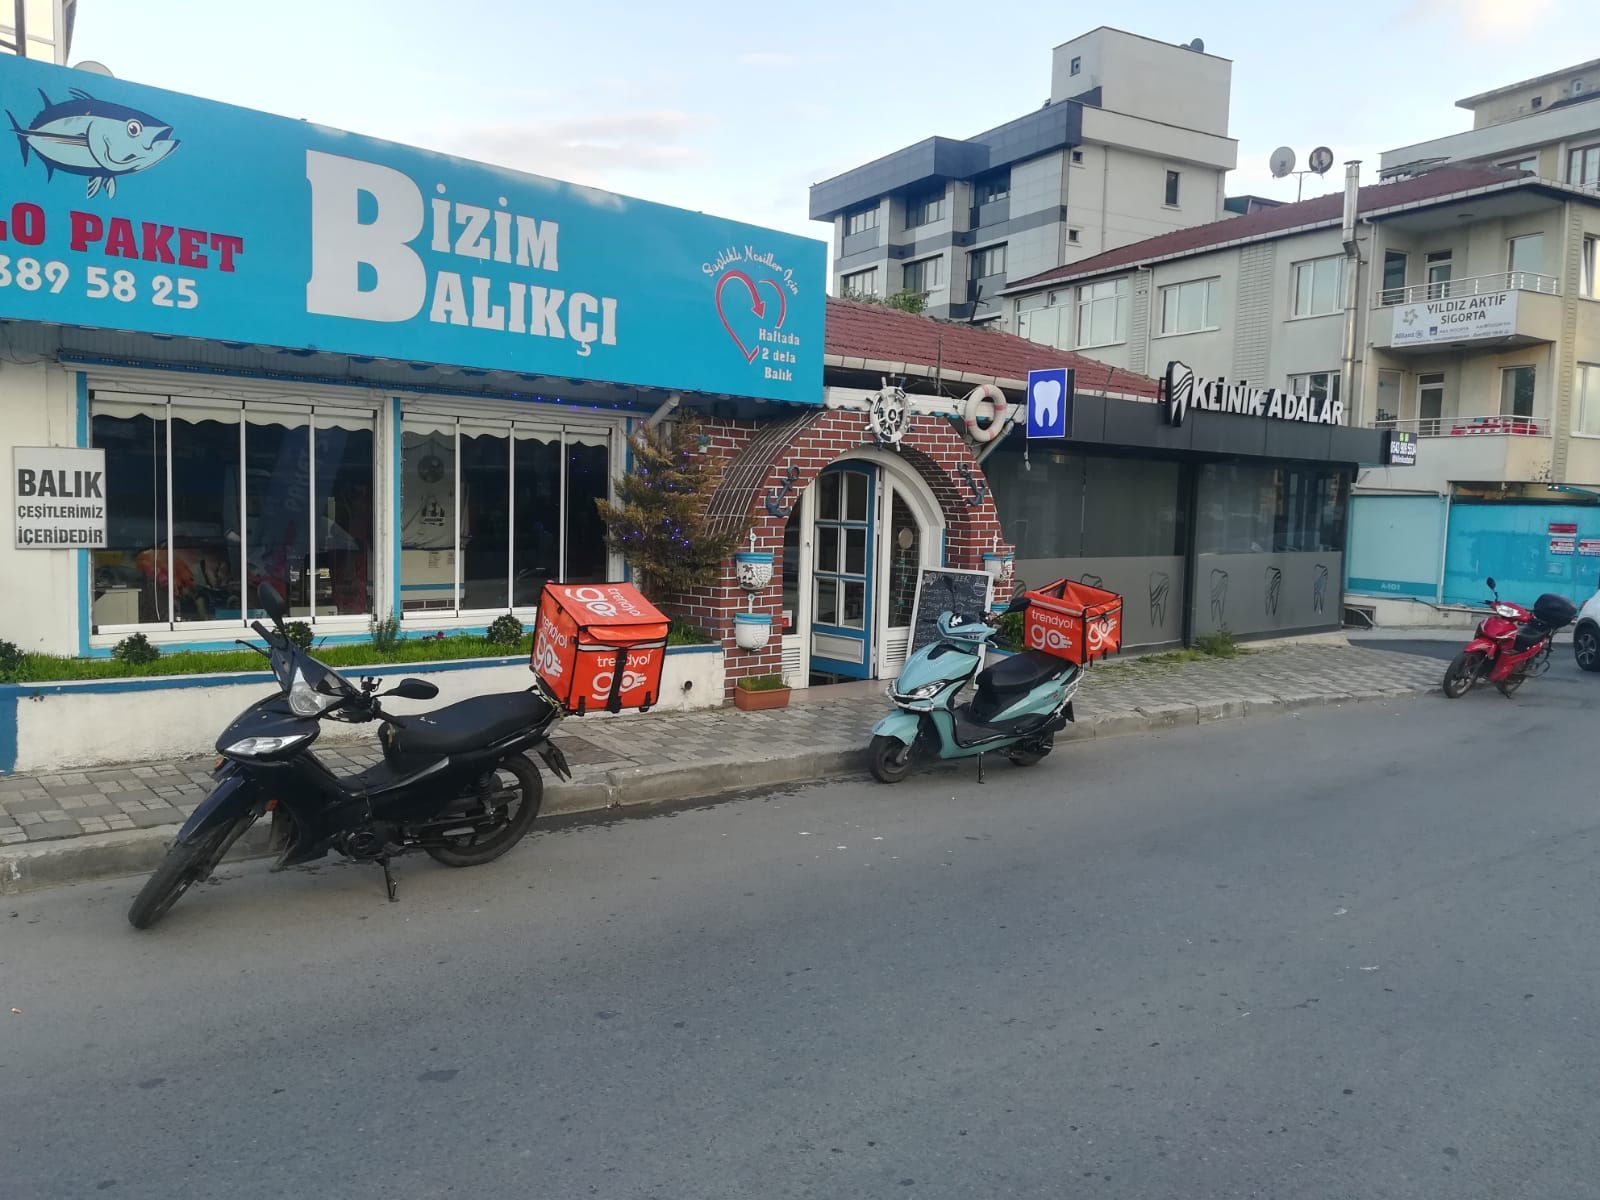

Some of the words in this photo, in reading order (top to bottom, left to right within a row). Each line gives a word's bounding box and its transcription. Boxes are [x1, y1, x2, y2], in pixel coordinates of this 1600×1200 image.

[0, 202, 45, 246] O
[70, 210, 243, 272] PAKET
[86, 266, 137, 302] 58
[152, 275, 199, 309] 25
[1426, 299, 1467, 315] YILDIZ
[1469, 293, 1507, 310] AKTİF
[759, 328, 800, 346] Haftada
[762, 348, 769, 360] 2
[764, 366, 793, 382] Balık
[1191, 376, 1265, 416] KLİNİK
[1267, 388, 1344, 426] ADALAR
[18, 469, 103, 498] BALIK
[18, 504, 103, 519] ÇEŞİTLERİMİZ
[18, 526, 103, 545] İÇERİDEDİR
[564, 587, 617, 617] go
[1032, 609, 1073, 630] trendyol
[1031, 624, 1072, 650] go
[1087, 618, 1117, 650] go
[534, 632, 563, 677] go
[597, 652, 652, 668] tredyol
[592, 670, 647, 700] go
